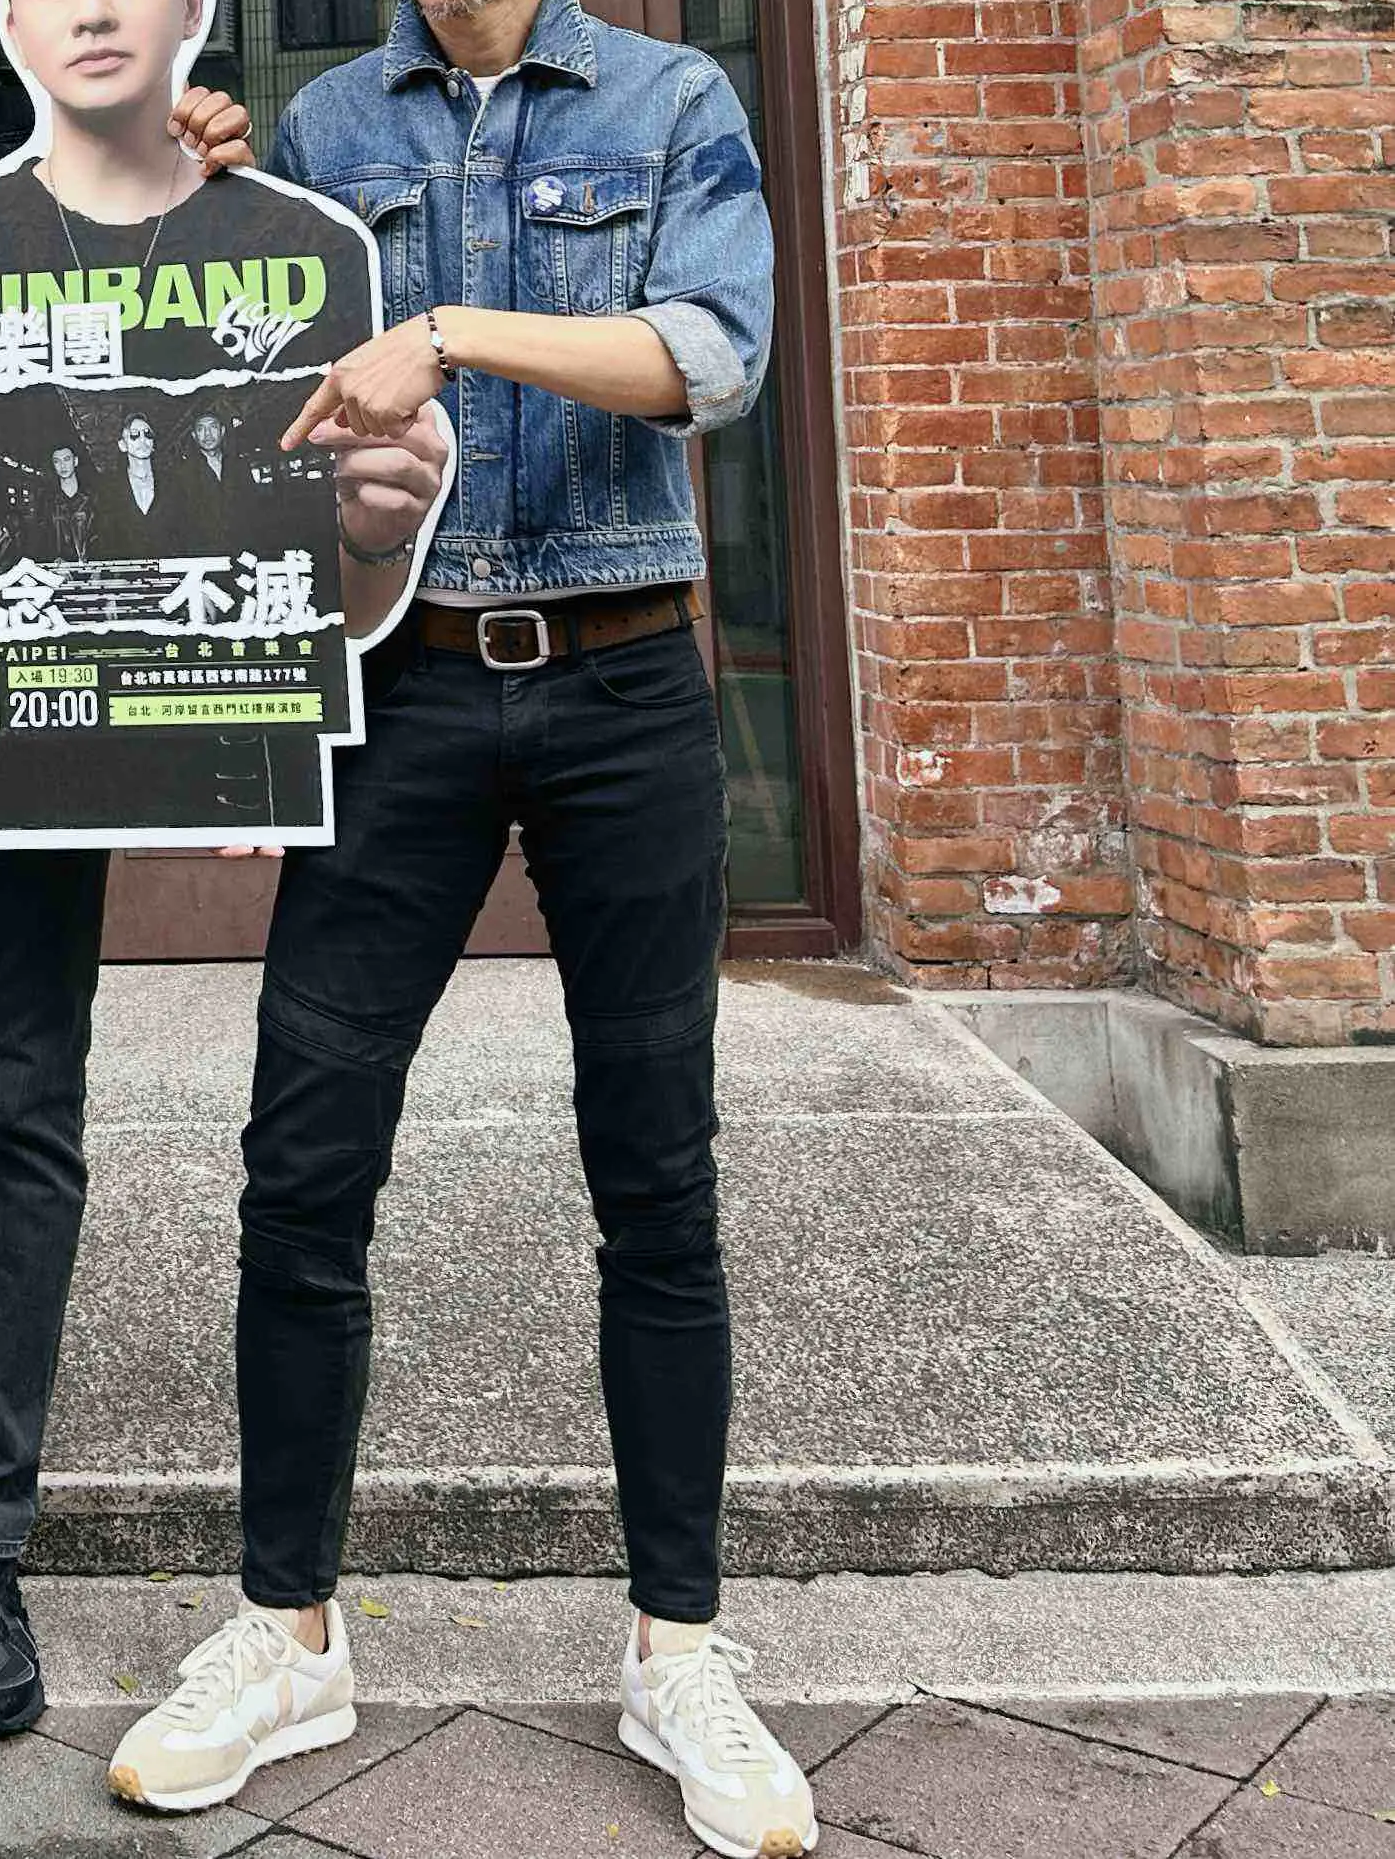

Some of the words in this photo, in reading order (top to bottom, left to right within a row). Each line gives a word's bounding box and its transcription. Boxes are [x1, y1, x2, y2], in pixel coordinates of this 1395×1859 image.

[158, 550, 316, 628] 不滅
[15, 671, 43, 684] 入場
[48, 667, 93, 684] 19:30
[9, 690, 99, 728] 20:00
